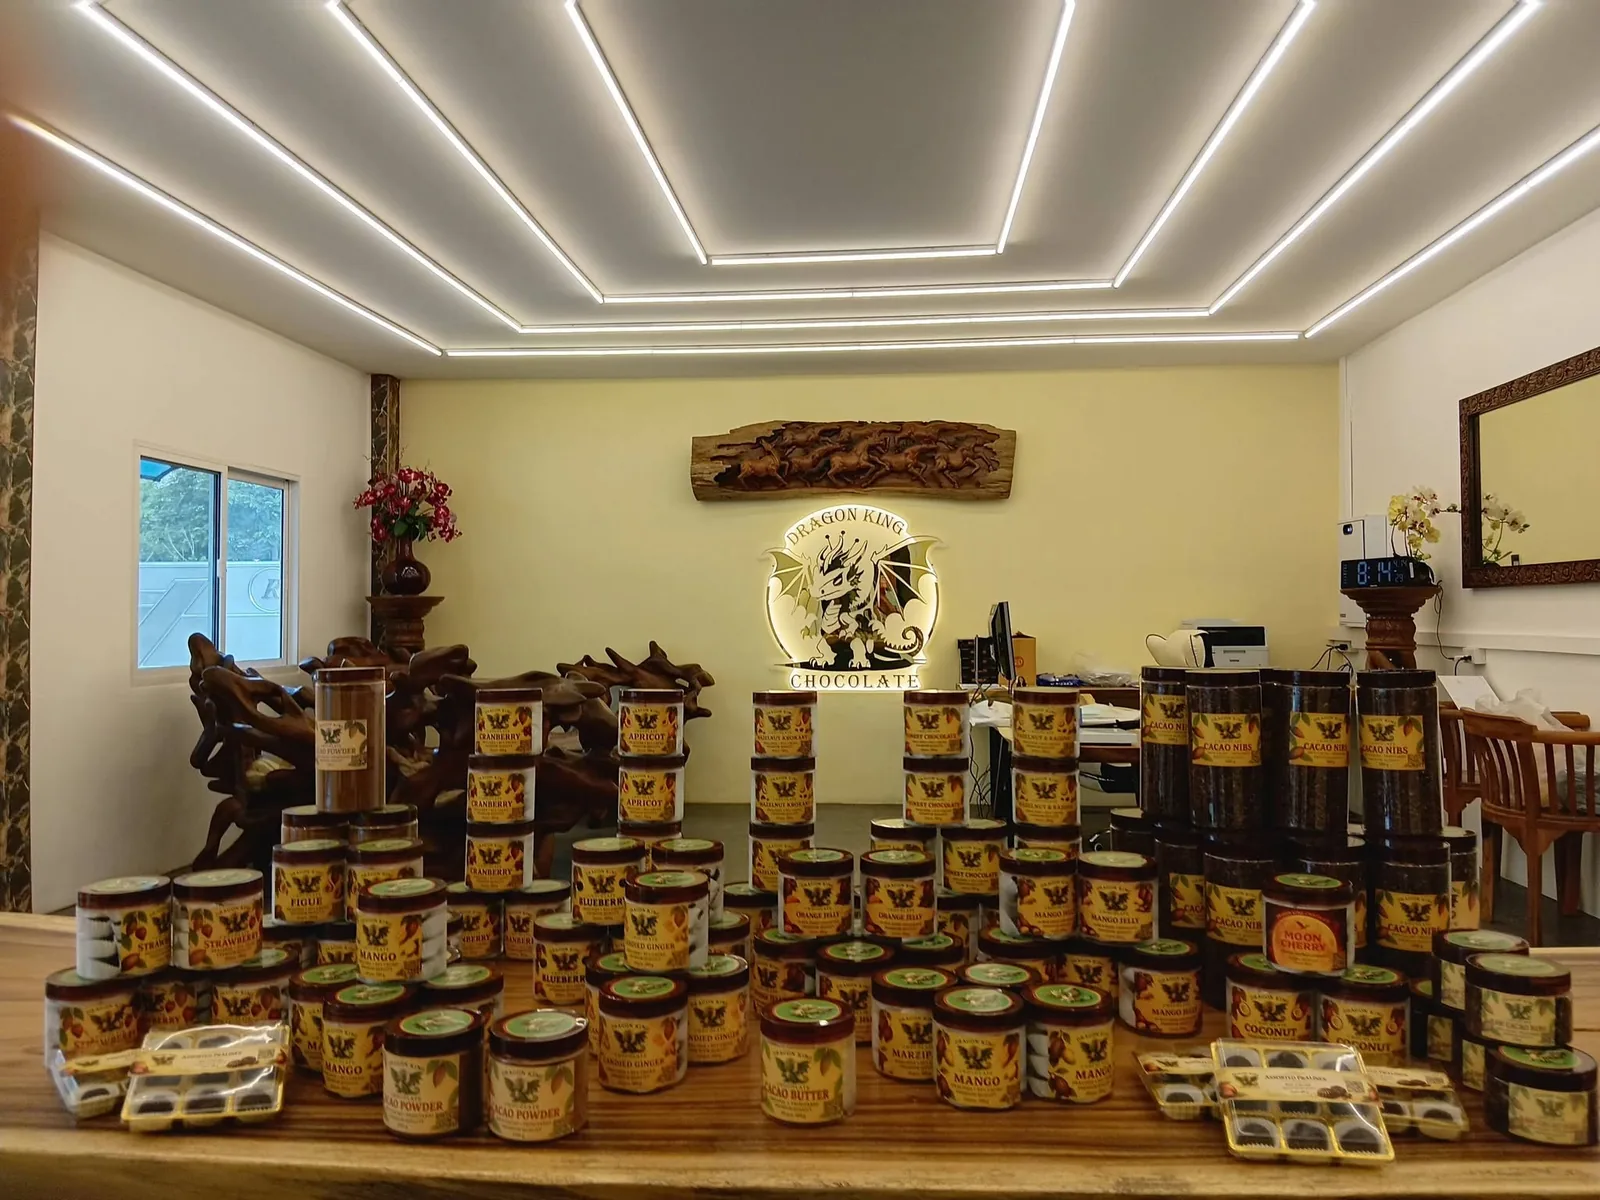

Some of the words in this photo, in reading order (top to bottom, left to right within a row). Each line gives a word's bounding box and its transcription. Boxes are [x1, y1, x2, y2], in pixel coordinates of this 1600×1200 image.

[786, 507, 857, 546] DRAGON
[862, 508, 905, 536] KING
[1357, 561, 1391, 585] 8:14
[790, 674, 919, 689] CHOCOLATE
[1150, 722, 1174, 731] CACAO
[1176, 722, 1186, 731] NI
[479, 733, 521, 741] CRANBERRY
[628, 733, 665, 741] APRICOT
[327, 747, 356, 755] POWDER
[1204, 743, 1231, 752] CACAO
[1233, 743, 1252, 752] NIBS
[1304, 743, 1332, 751] CACAO
[1386, 746, 1408, 755] NIBS
[471, 800, 513, 808] CRANBERRY
[626, 799, 663, 807] APRICOT
[470, 868, 512, 876] CRANBERRY
[290, 898, 323, 907] FIGUE
[1184, 904, 1204, 913] CACA
[795, 910, 822, 920] ORANGE
[878, 912, 906, 921] ORANGE
[1091, 914, 1118, 924] MANGO
[1119, 916, 1140, 924] JELLY
[1215, 916, 1243, 928] CACAO
[1246, 920, 1262, 930] NIB
[1388, 924, 1419, 935] CACAO
[463, 933, 490, 944] BERRY
[1284, 930, 1322, 942] MOON
[646, 942, 676, 950] GINGER
[1280, 940, 1326, 951] CHERRY
[359, 950, 397, 962] MANGO
[542, 974, 586, 984] BLUEBERR
[1152, 1008, 1182, 1016] MANGO
[1244, 1023, 1298, 1037] COCONUT
[688, 1034, 713, 1044] NDIED
[1336, 1037, 1392, 1052] COCONUT
[892, 1048, 932, 1060] MARZIP
[634, 1058, 665, 1068] GINGER
[325, 1062, 362, 1075] MANGO
[954, 1073, 1000, 1087] MANGO
[790, 1089, 829, 1101] BUTTER
[400, 1101, 444, 1112] POWDER
[494, 1104, 514, 1118] ACAO
[516, 1108, 560, 1121] POWDER
